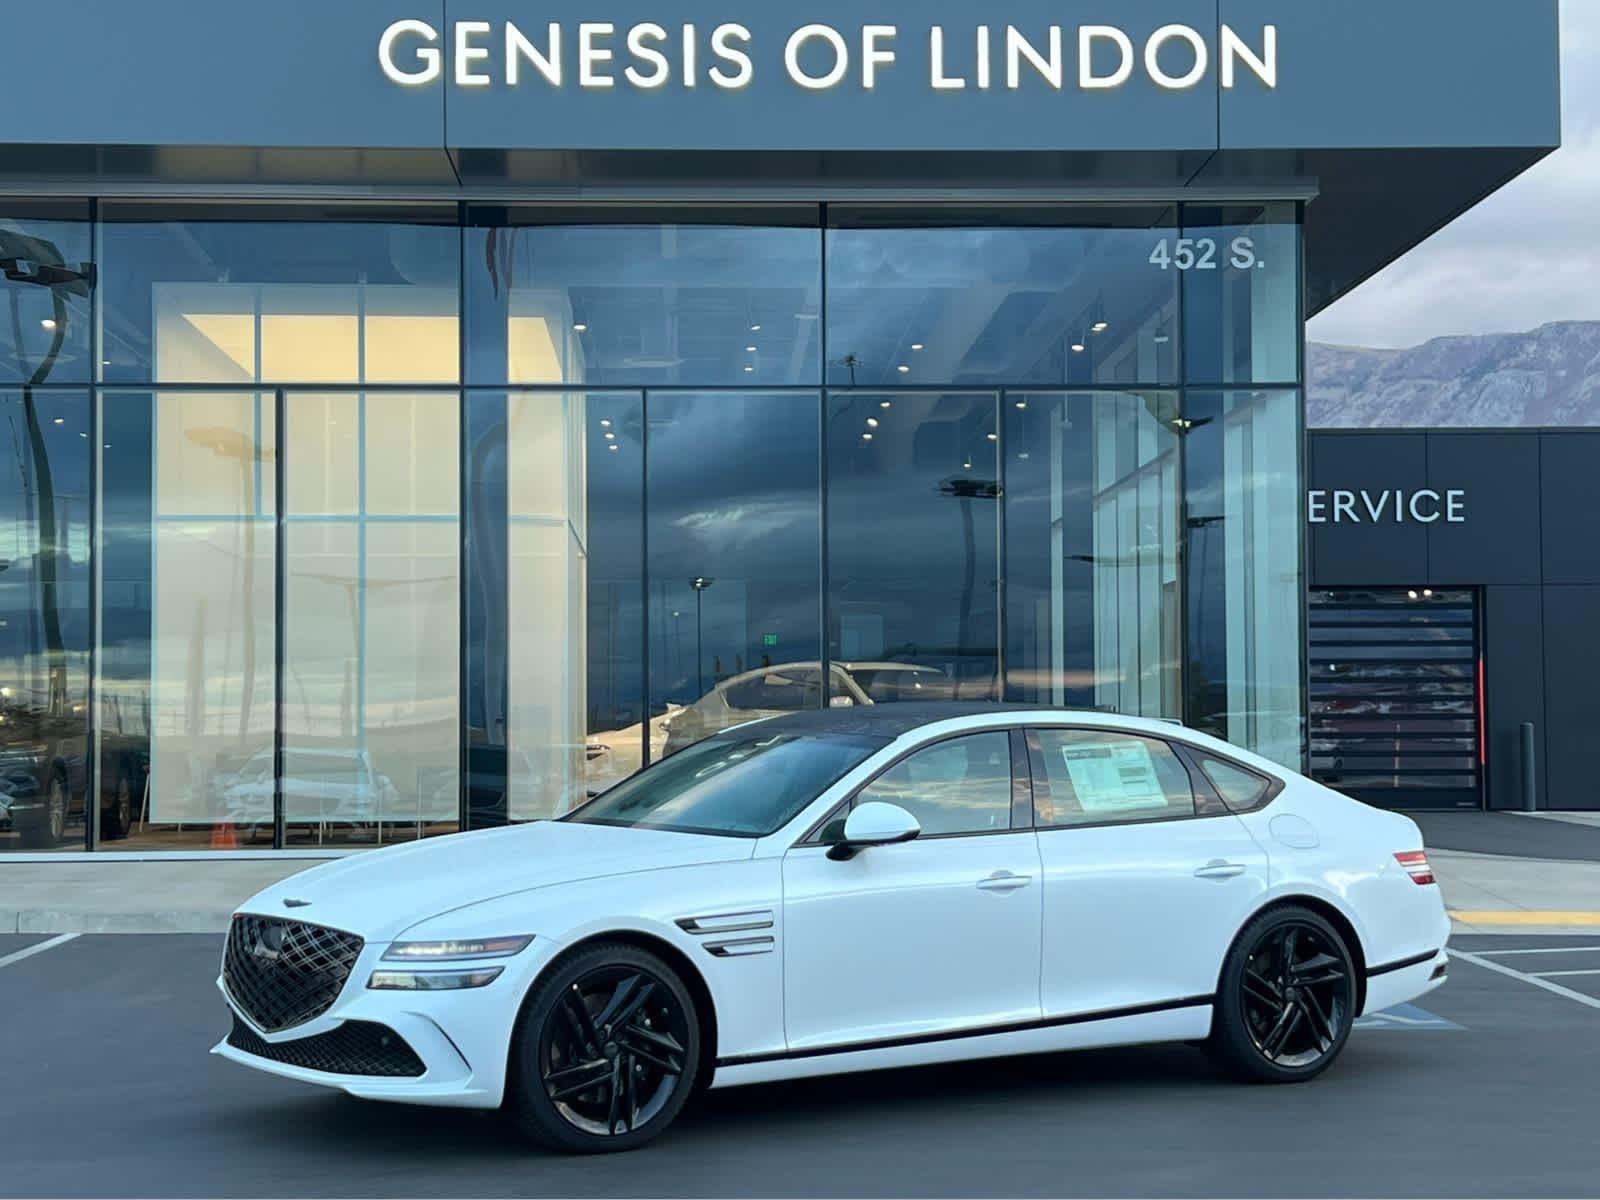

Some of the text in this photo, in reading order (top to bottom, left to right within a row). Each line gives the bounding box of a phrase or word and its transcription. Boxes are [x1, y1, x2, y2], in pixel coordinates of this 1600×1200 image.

[378, 19, 1276, 89] GENESIS OF LINDON
[1148, 238, 1265, 270] 452 S.
[1308, 489, 1466, 523] ERVICE
